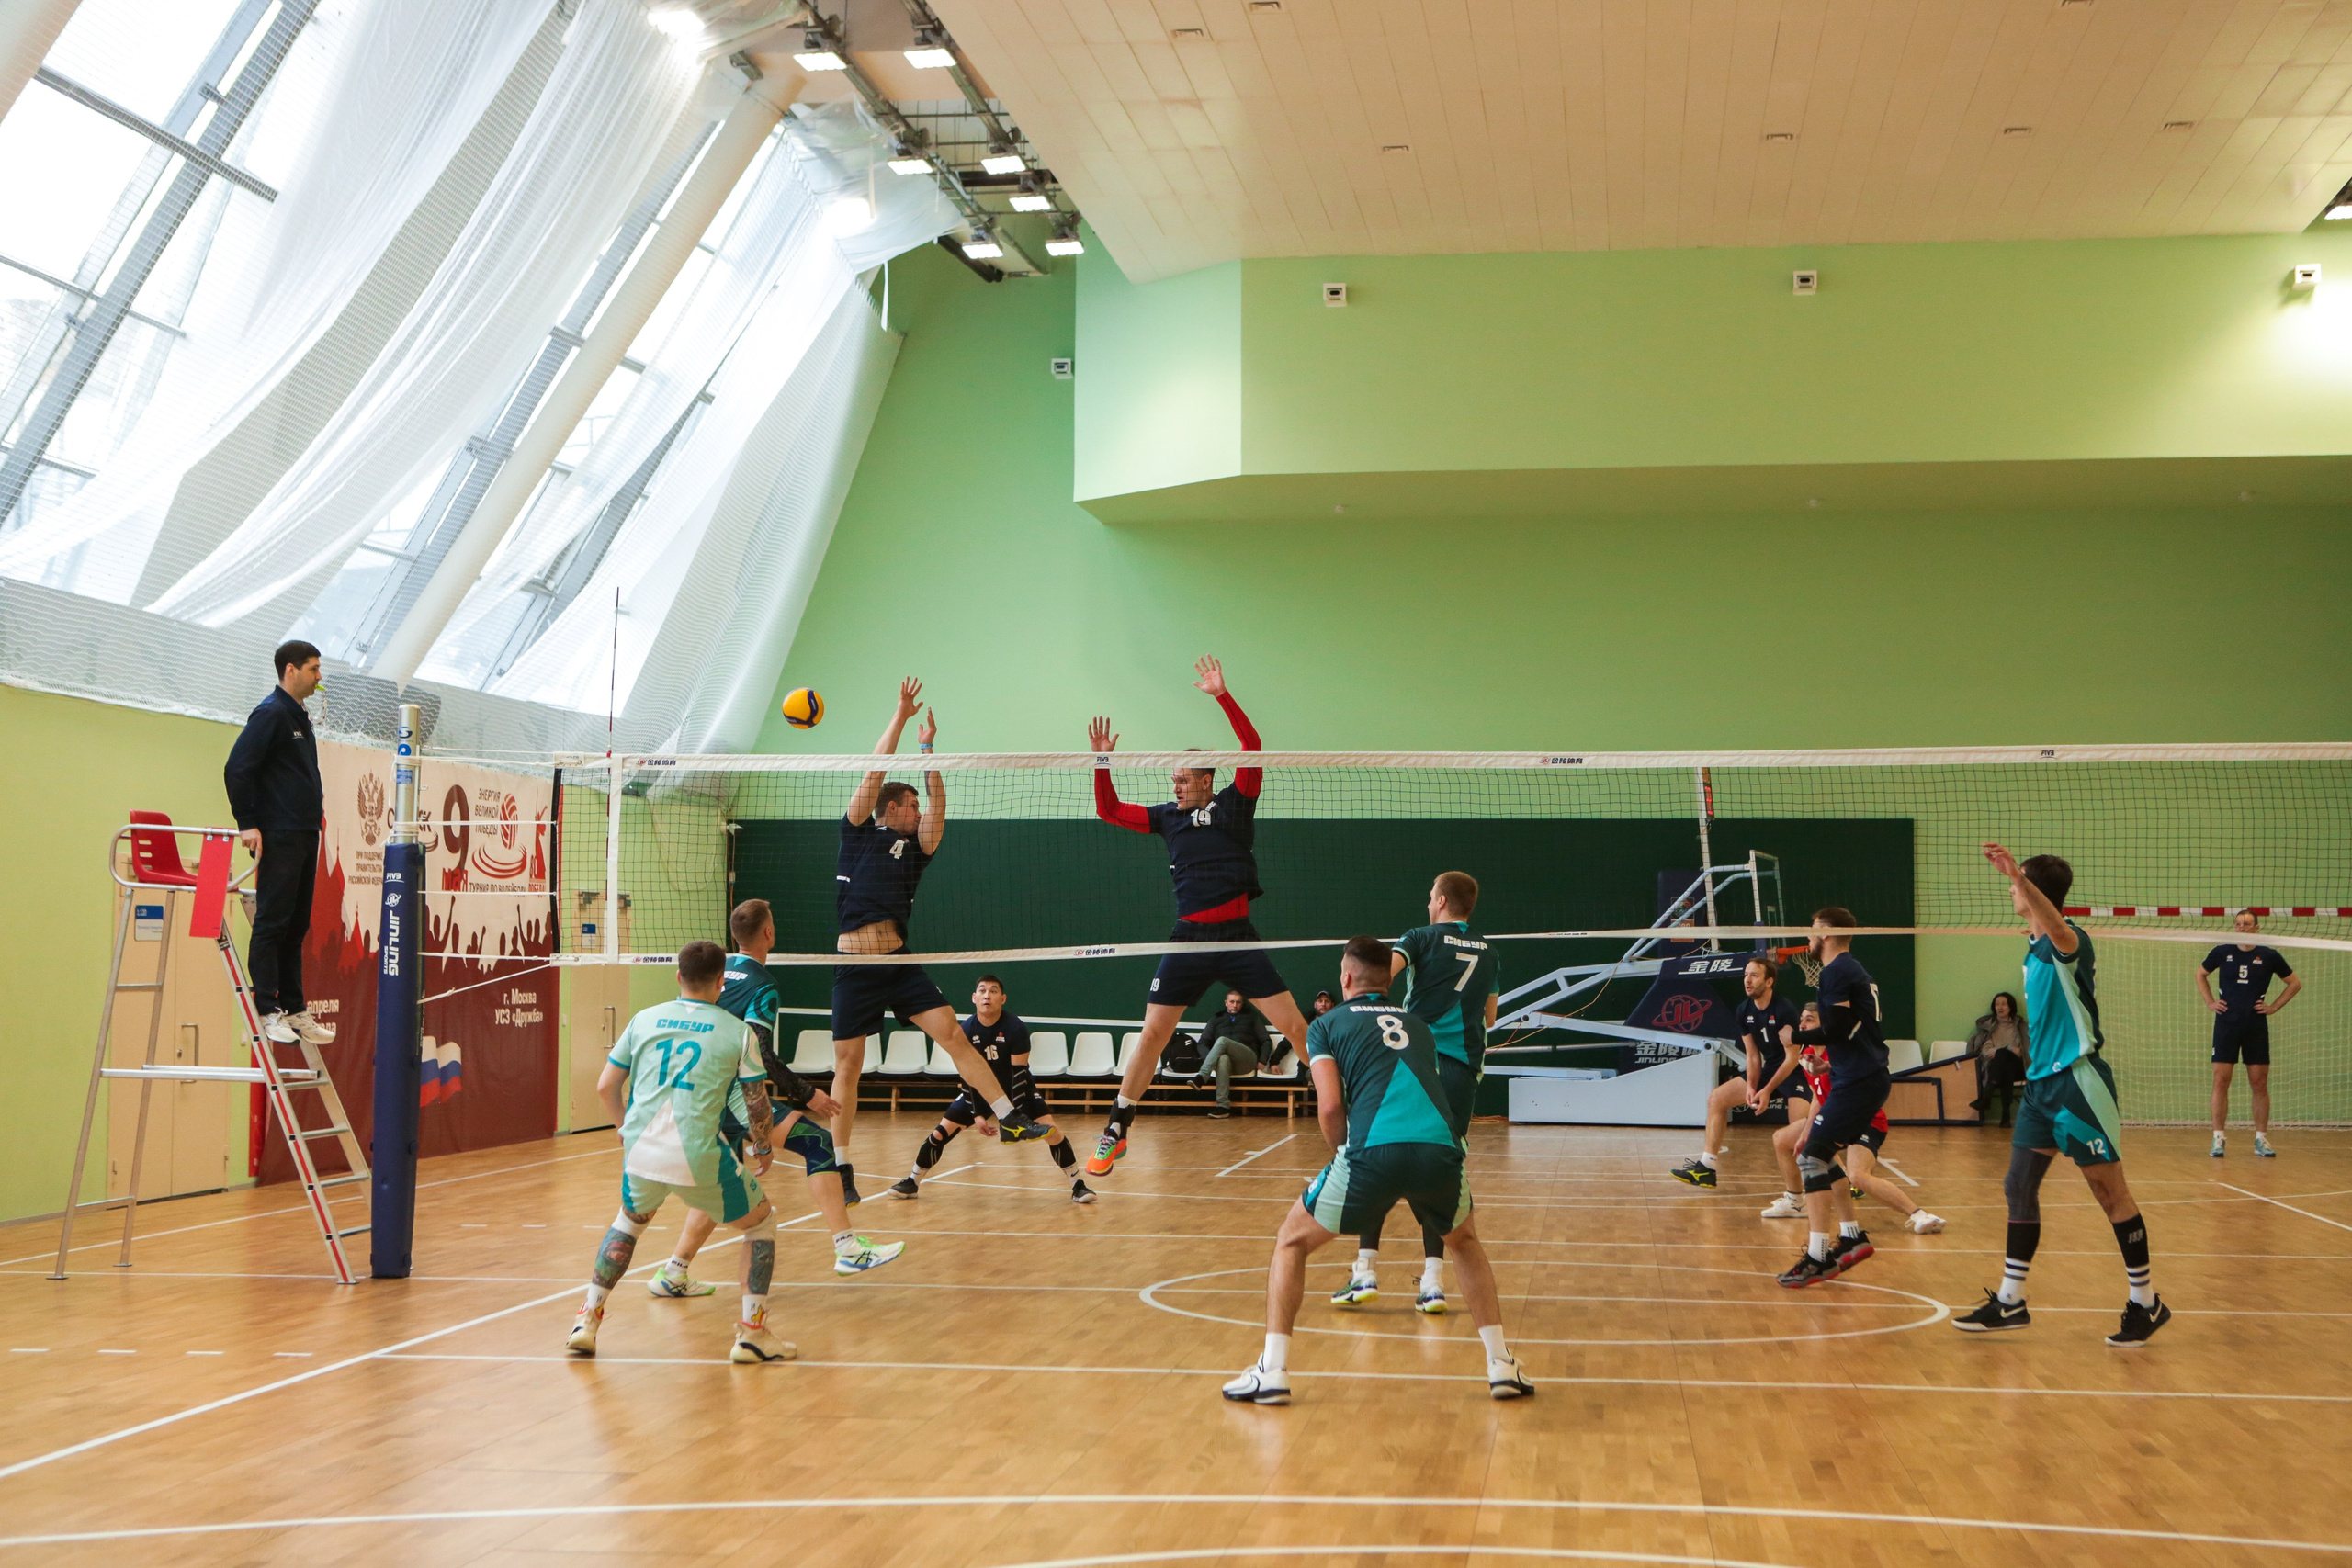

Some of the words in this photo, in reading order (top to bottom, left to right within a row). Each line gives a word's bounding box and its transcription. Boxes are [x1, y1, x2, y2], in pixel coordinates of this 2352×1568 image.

[478, 788, 501, 802] ЭНЕРГИЯ
[474, 804, 499, 818] ВЕЛИКОЙ
[1191, 809, 1211, 827] 19
[443, 784, 469, 870] 9
[889, 840, 905, 860] 4
[388, 909, 400, 976] JINLING
[1443, 935, 1488, 951] СИБУР
[1454, 952, 1479, 992] 7
[1688, 958, 1734, 974] 金陵
[2238, 965, 2248, 979] 5
[1149, 978, 1160, 992] 19
[503, 993, 509, 1005] г.
[511, 988, 537, 1005] Москва
[307, 999, 340, 1019] апреля
[655, 1018, 715, 1033] СИБУР
[1376, 1014, 1410, 1050] 8
[1760, 1027, 1770, 1043] 1
[984, 1044, 999, 1061] 16
[655, 1037, 702, 1091] 12
[2086, 1138, 2106, 1156] 12
